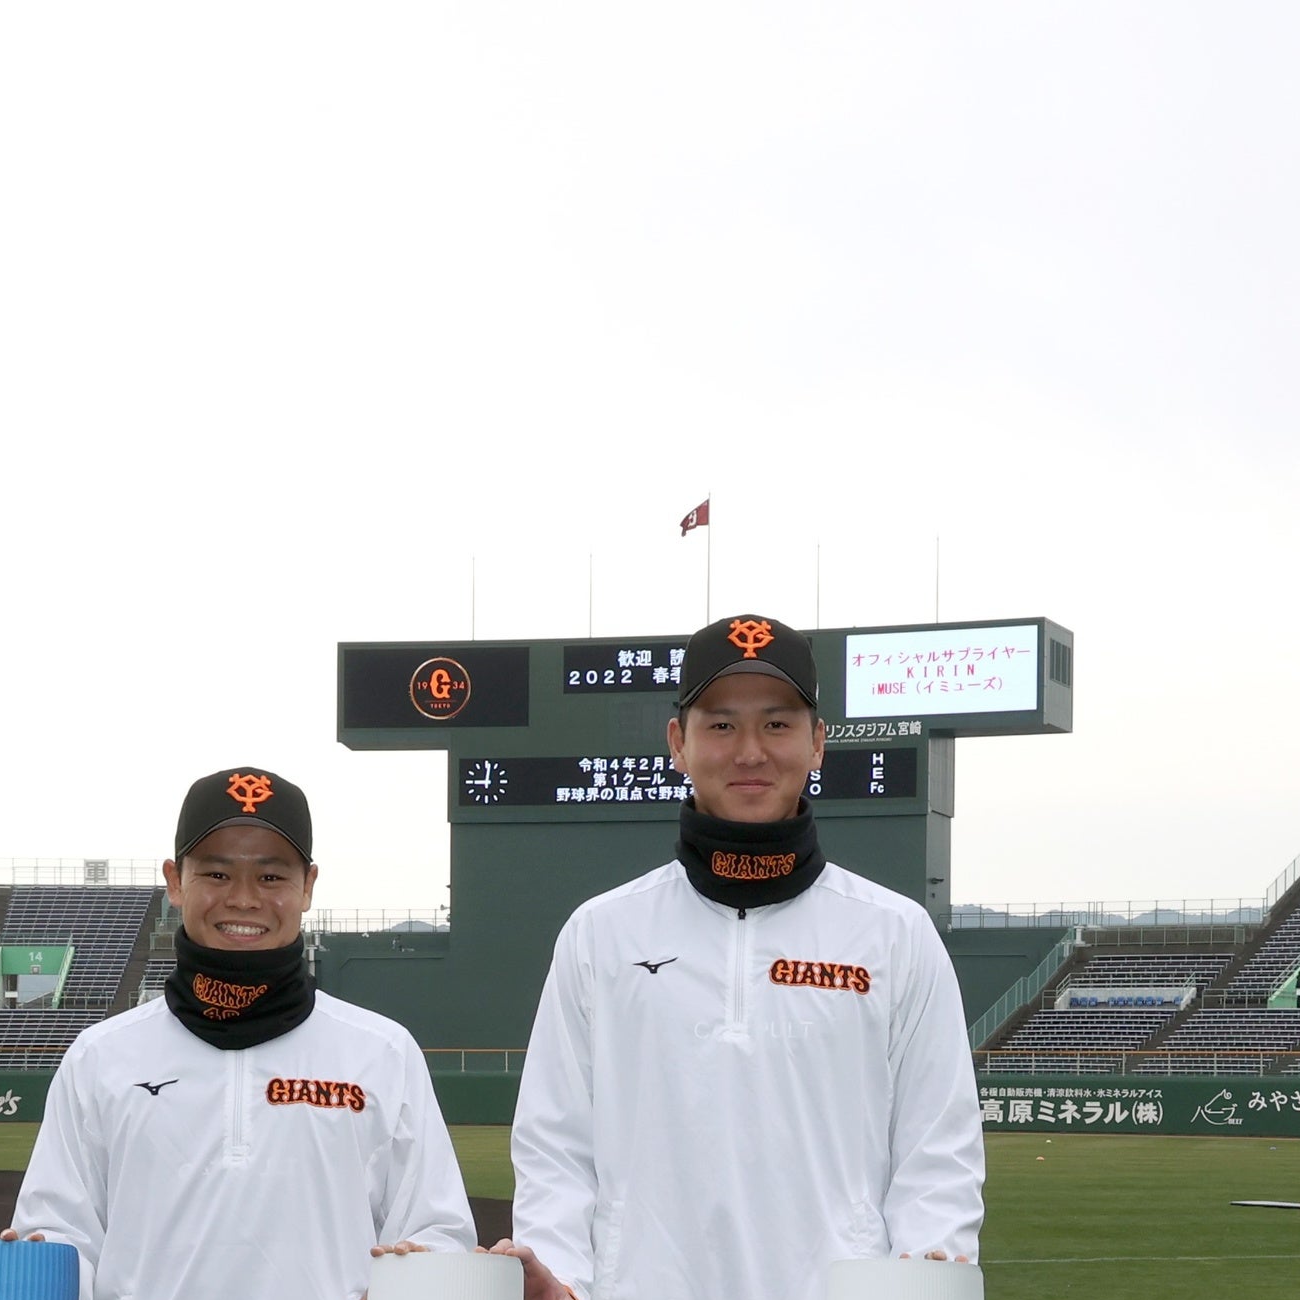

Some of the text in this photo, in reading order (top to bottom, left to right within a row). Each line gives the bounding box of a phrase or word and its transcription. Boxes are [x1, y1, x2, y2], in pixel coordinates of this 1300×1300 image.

[617, 649, 652, 668] 歓迎
[852, 646, 1031, 667] オフィシャルサプライヤー
[568, 669, 632, 685] 2022
[906, 664, 976, 679] KIRIN
[430, 668, 451, 699] G
[872, 753, 884, 767] H
[593, 772, 666, 788] 第1クール
[809, 770, 821, 781] S
[872, 767, 884, 779] E
[870, 782, 884, 793] Fc
[85, 860, 107, 883] 軍
[711, 851, 796, 879] GIANTS
[28, 951, 43, 962] 14
[768, 958, 872, 995] GIANTS
[266, 1078, 367, 1113] GIANTS
